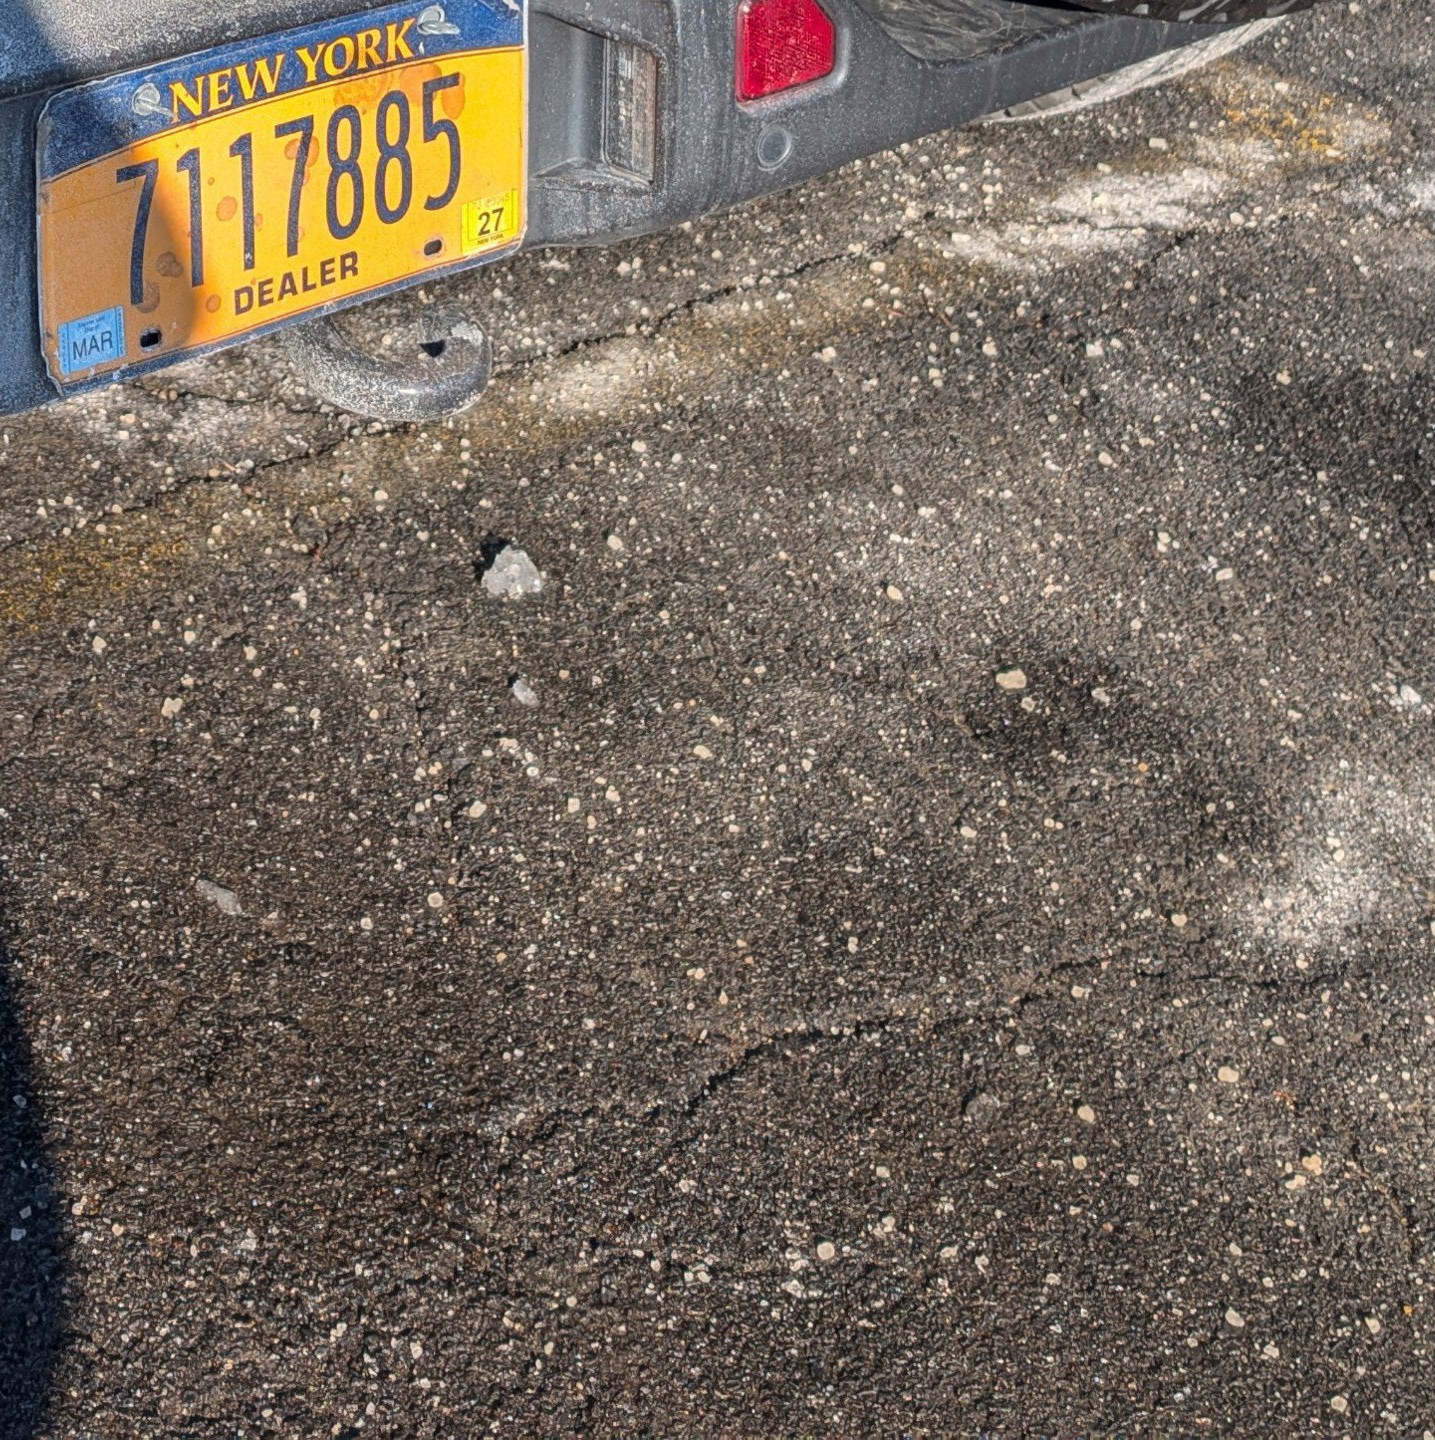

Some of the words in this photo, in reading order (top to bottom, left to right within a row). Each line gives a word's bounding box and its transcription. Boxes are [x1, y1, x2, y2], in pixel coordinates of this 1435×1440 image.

[168, 54, 282, 123] NEW
[295, 18, 415, 83] YORK
[116, 71, 461, 306] 7117885
[478, 207, 504, 236] 27
[234, 252, 359, 315] DEALER
[72, 331, 113, 359] MAR
